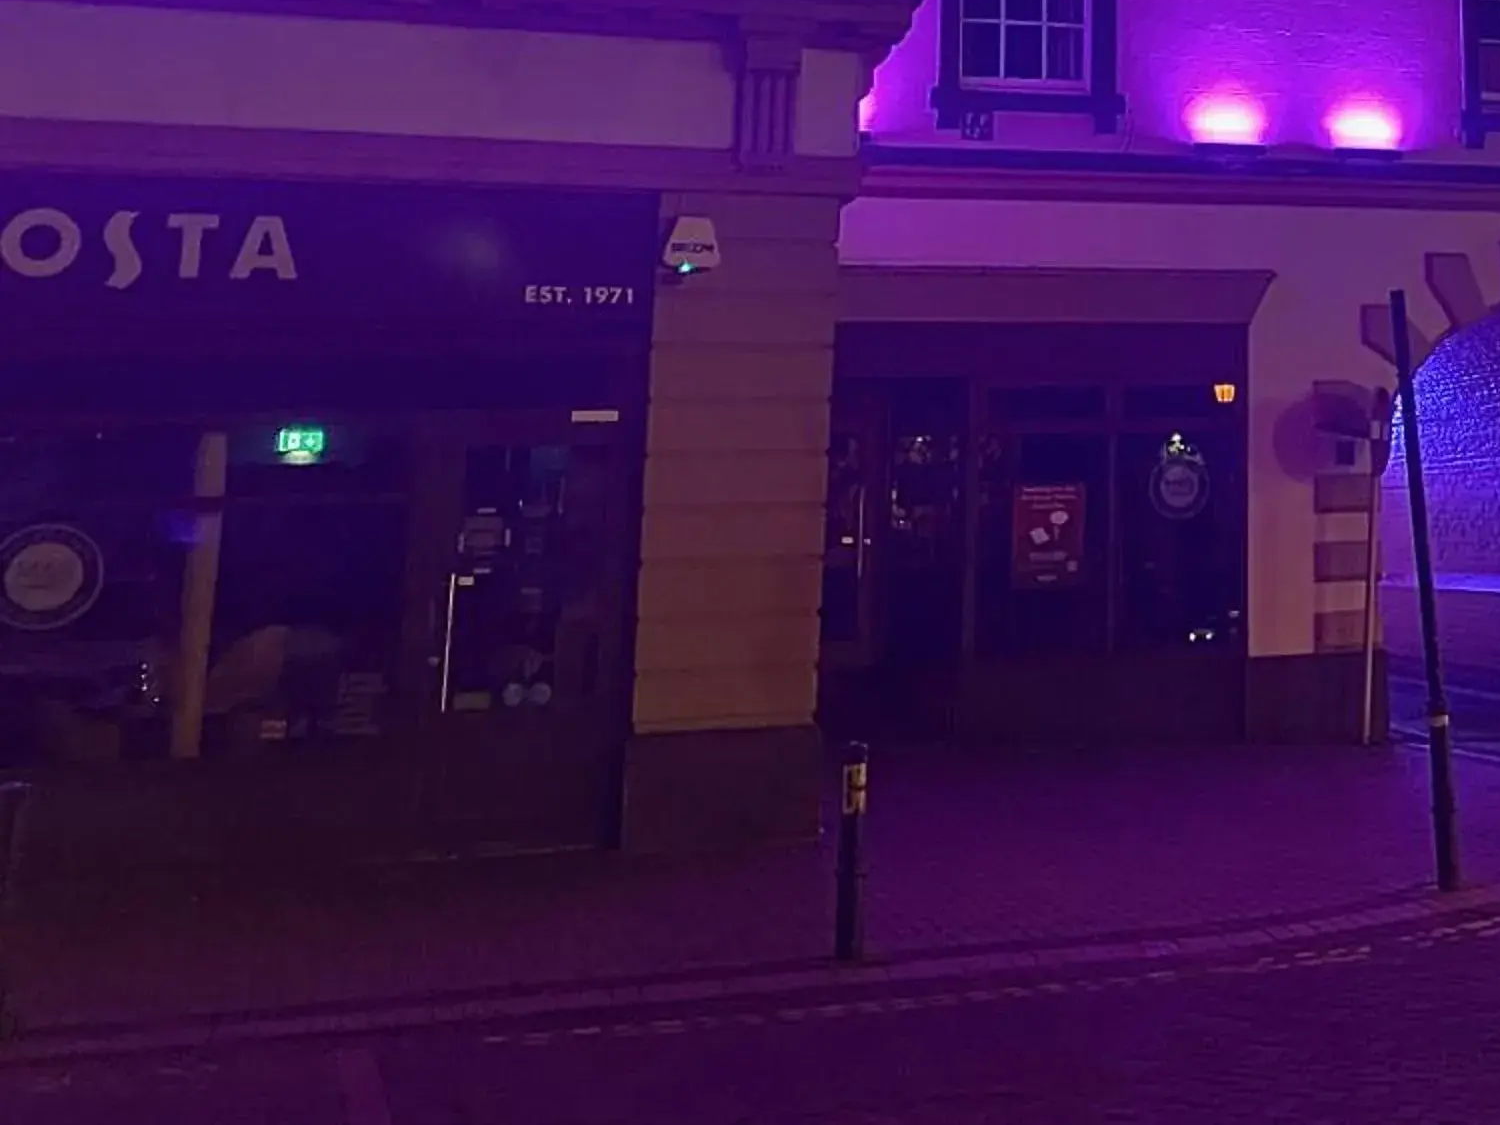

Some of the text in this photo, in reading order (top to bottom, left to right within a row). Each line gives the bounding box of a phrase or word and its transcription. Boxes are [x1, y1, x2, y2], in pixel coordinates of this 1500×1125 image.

[0, 207, 297, 290] OSTA
[525, 285, 633, 305] EST. 1971
